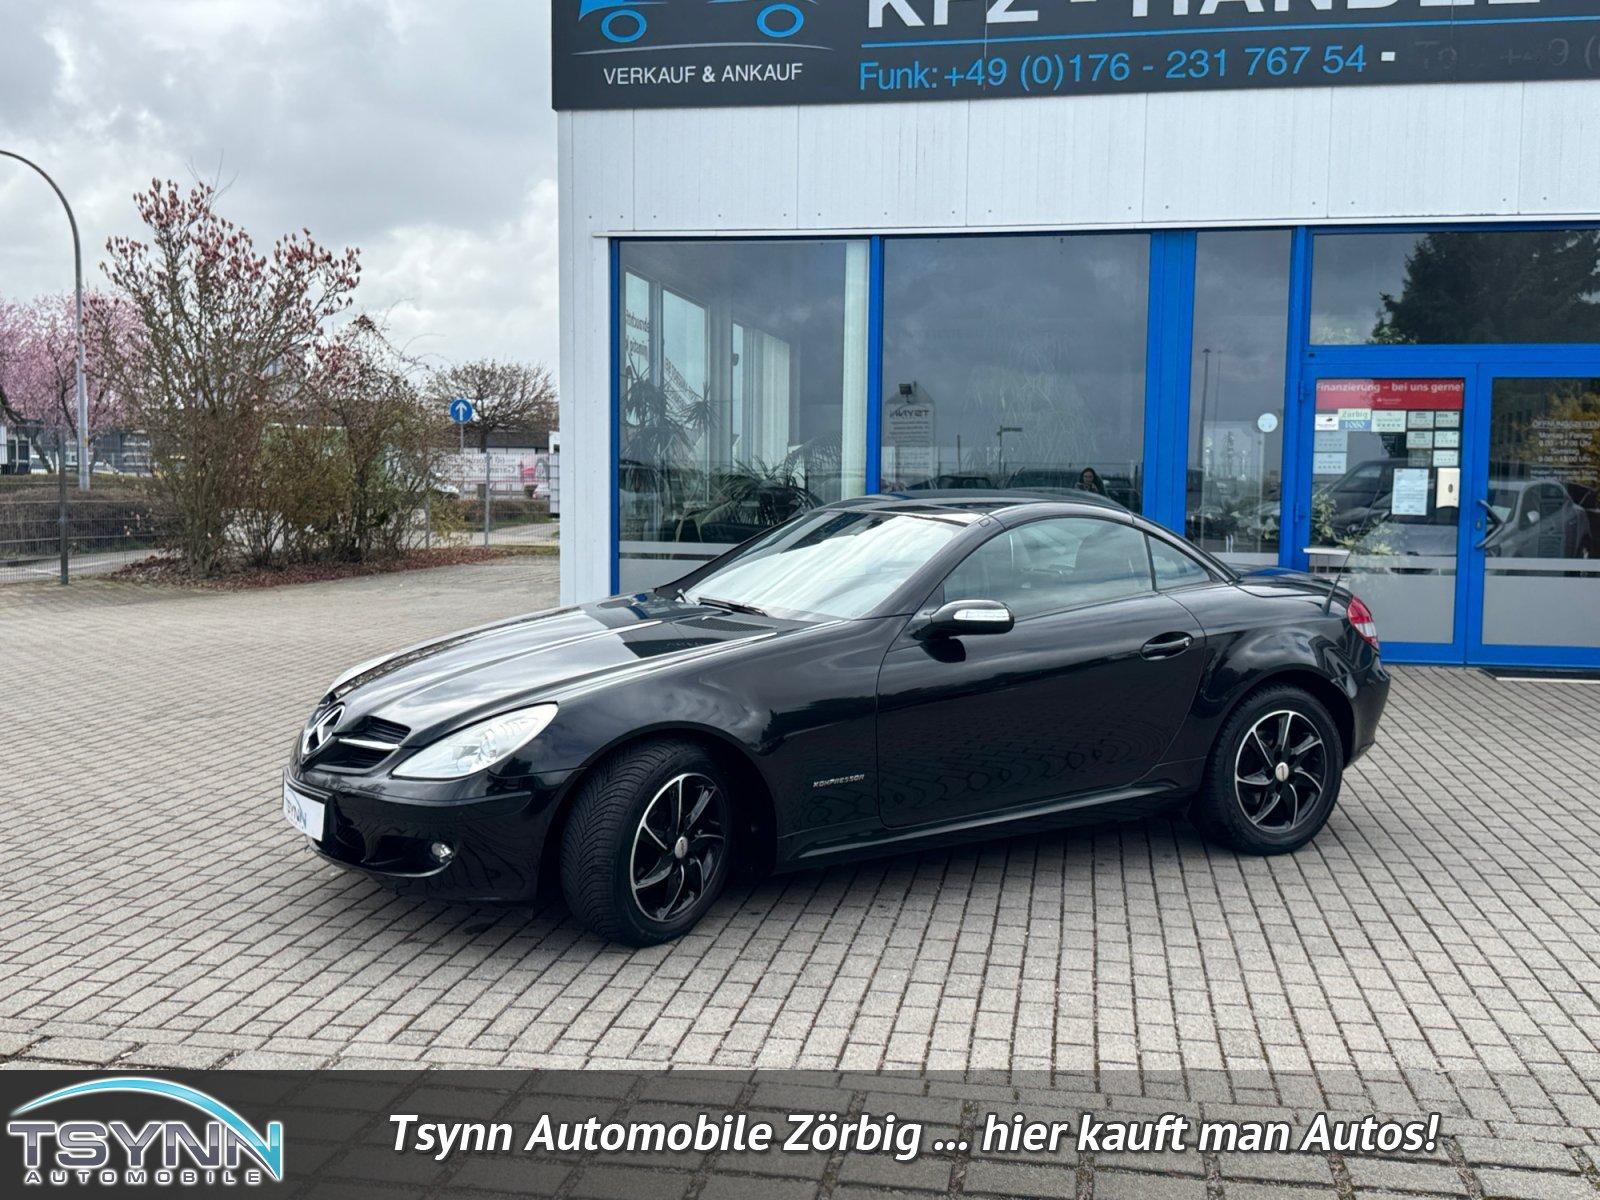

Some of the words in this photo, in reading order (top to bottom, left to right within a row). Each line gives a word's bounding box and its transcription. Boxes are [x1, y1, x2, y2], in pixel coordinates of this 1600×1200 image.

[603, 66, 697, 85] VERKAUF
[702, 66, 716, 83] &
[721, 62, 803, 82] ANKAUF
[860, 60, 938, 90] Funk:
[944, 58, 1008, 87] +49
[1020, 52, 1130, 91] (0)176
[1166, 49, 1226, 79] 231
[1245, 47, 1311, 76] 767
[1322, 45, 1367, 74] 54
[1316, 382, 1380, 393] Finanzierung
[1391, 382, 1407, 392] bei
[1410, 383, 1429, 392] uns
